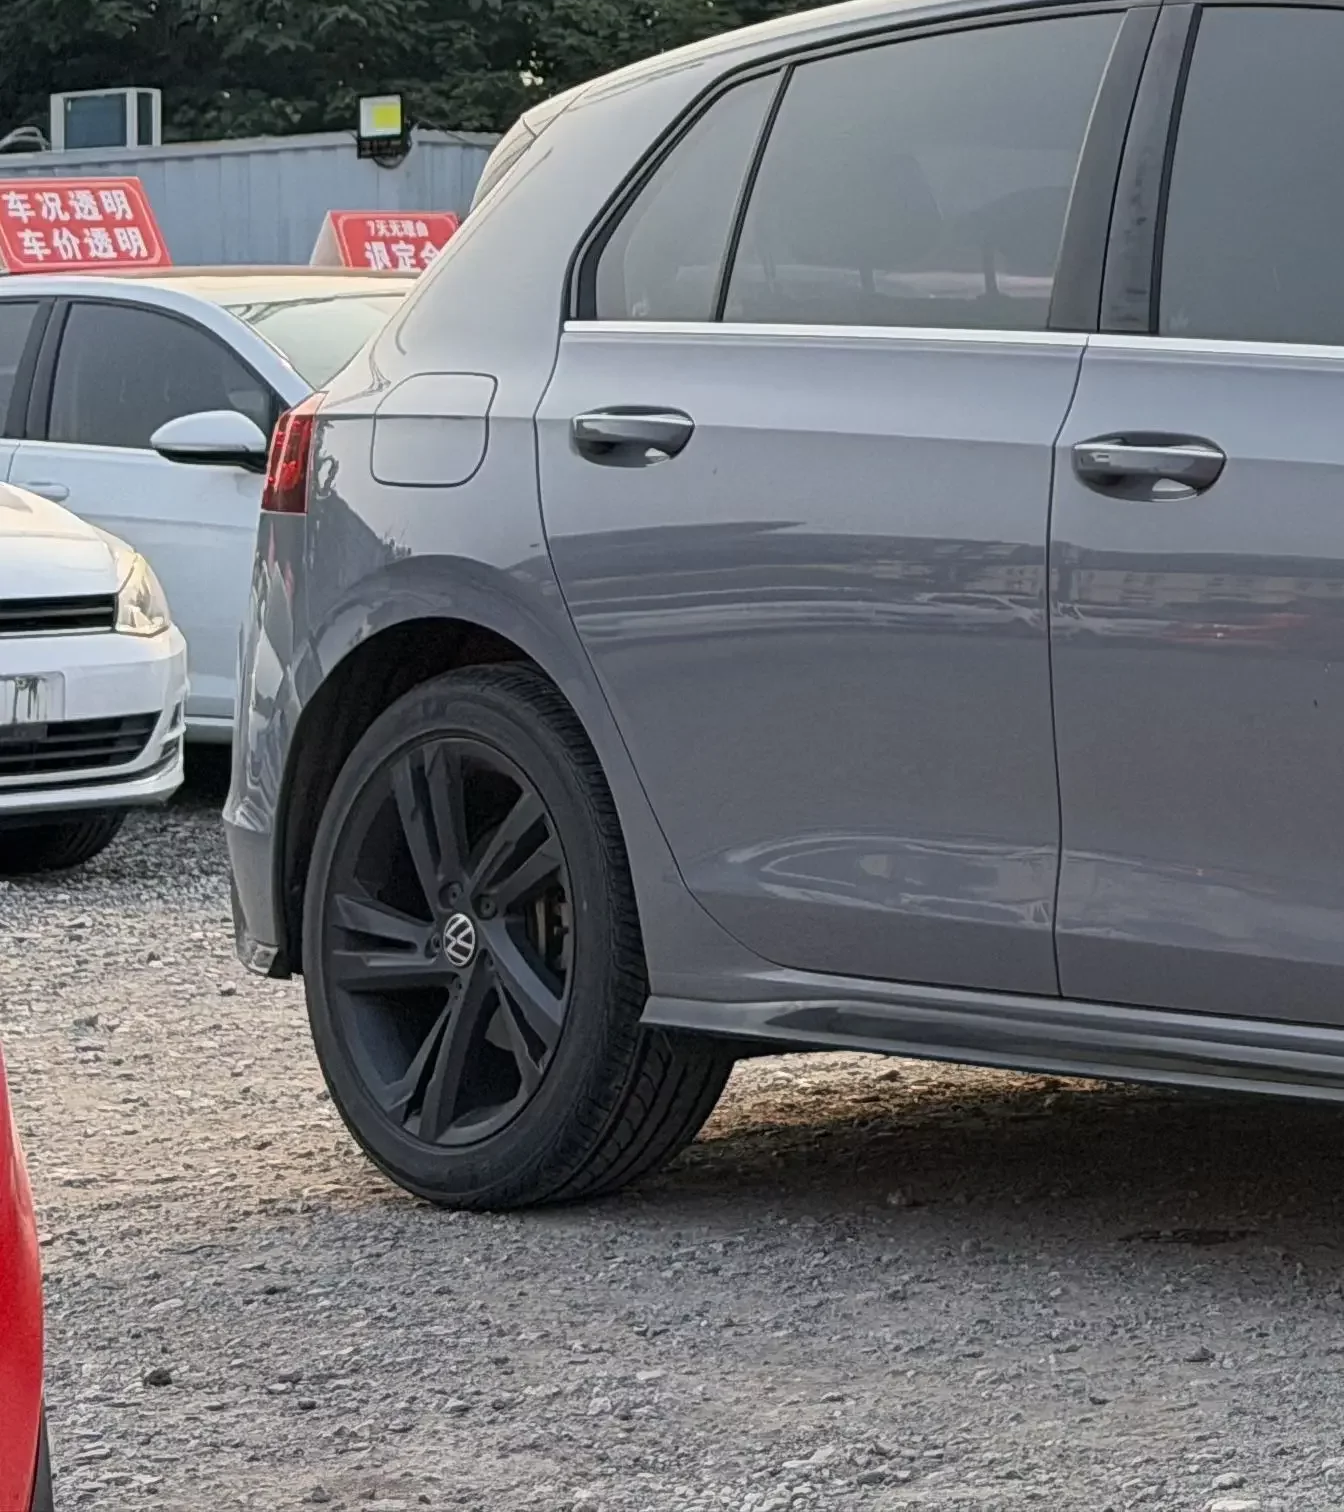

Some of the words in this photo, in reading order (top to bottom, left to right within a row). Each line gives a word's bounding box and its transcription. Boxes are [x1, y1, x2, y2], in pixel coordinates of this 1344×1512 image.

[1, 189, 134, 224] 车况透明
[16, 227, 149, 261] 车价透明
